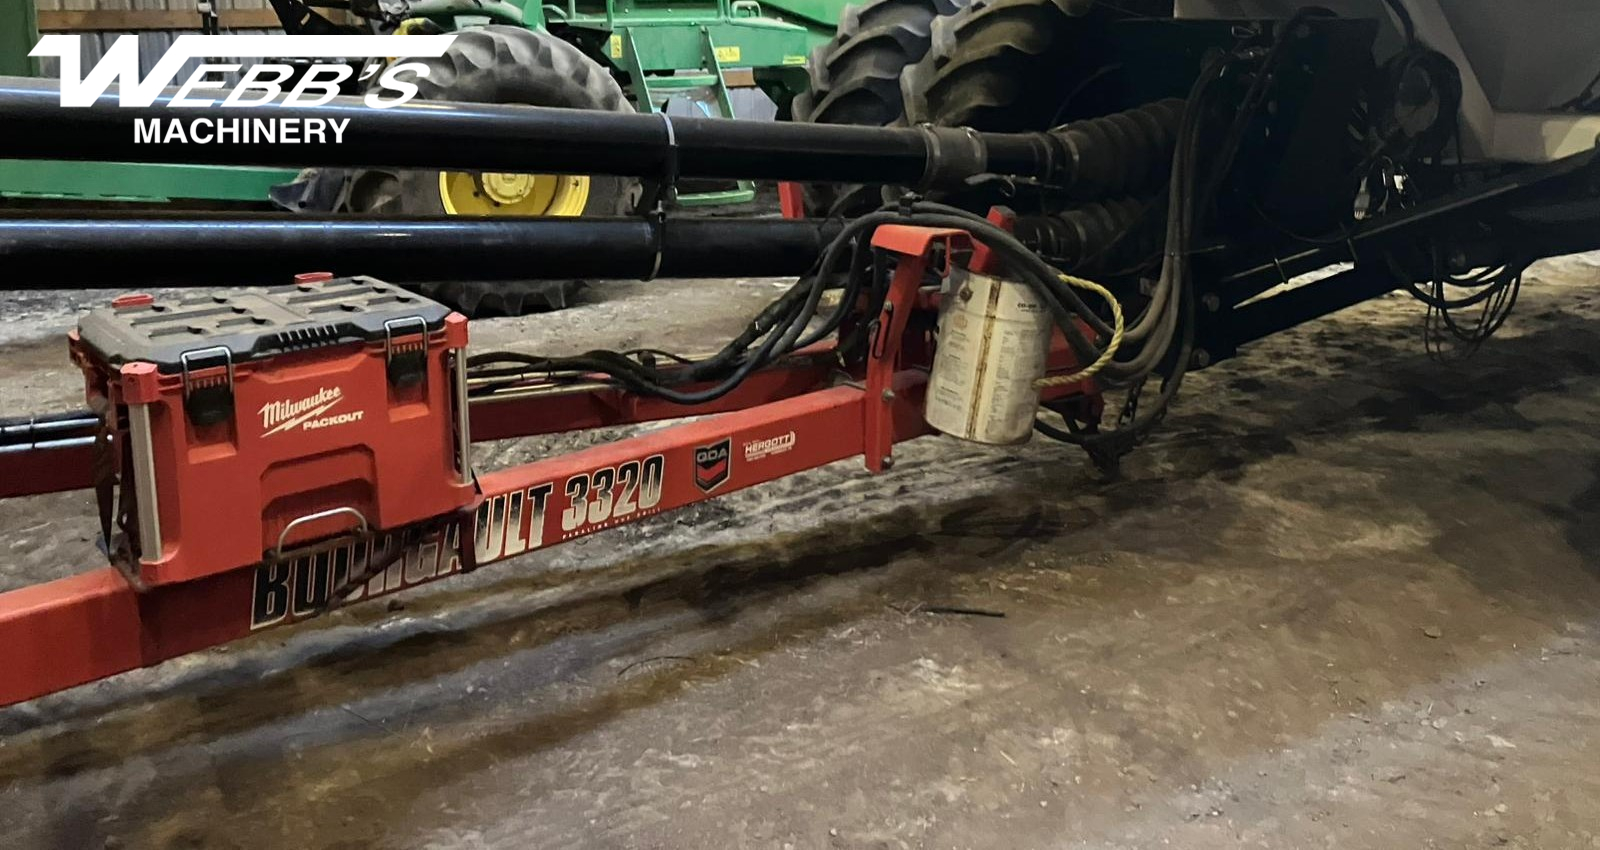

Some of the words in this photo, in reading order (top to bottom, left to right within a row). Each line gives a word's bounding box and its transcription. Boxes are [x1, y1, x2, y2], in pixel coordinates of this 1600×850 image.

[257, 386, 342, 428] Milwaukee
[303, 411, 364, 430] PACKOUT
[562, 454, 664, 531] 3320
